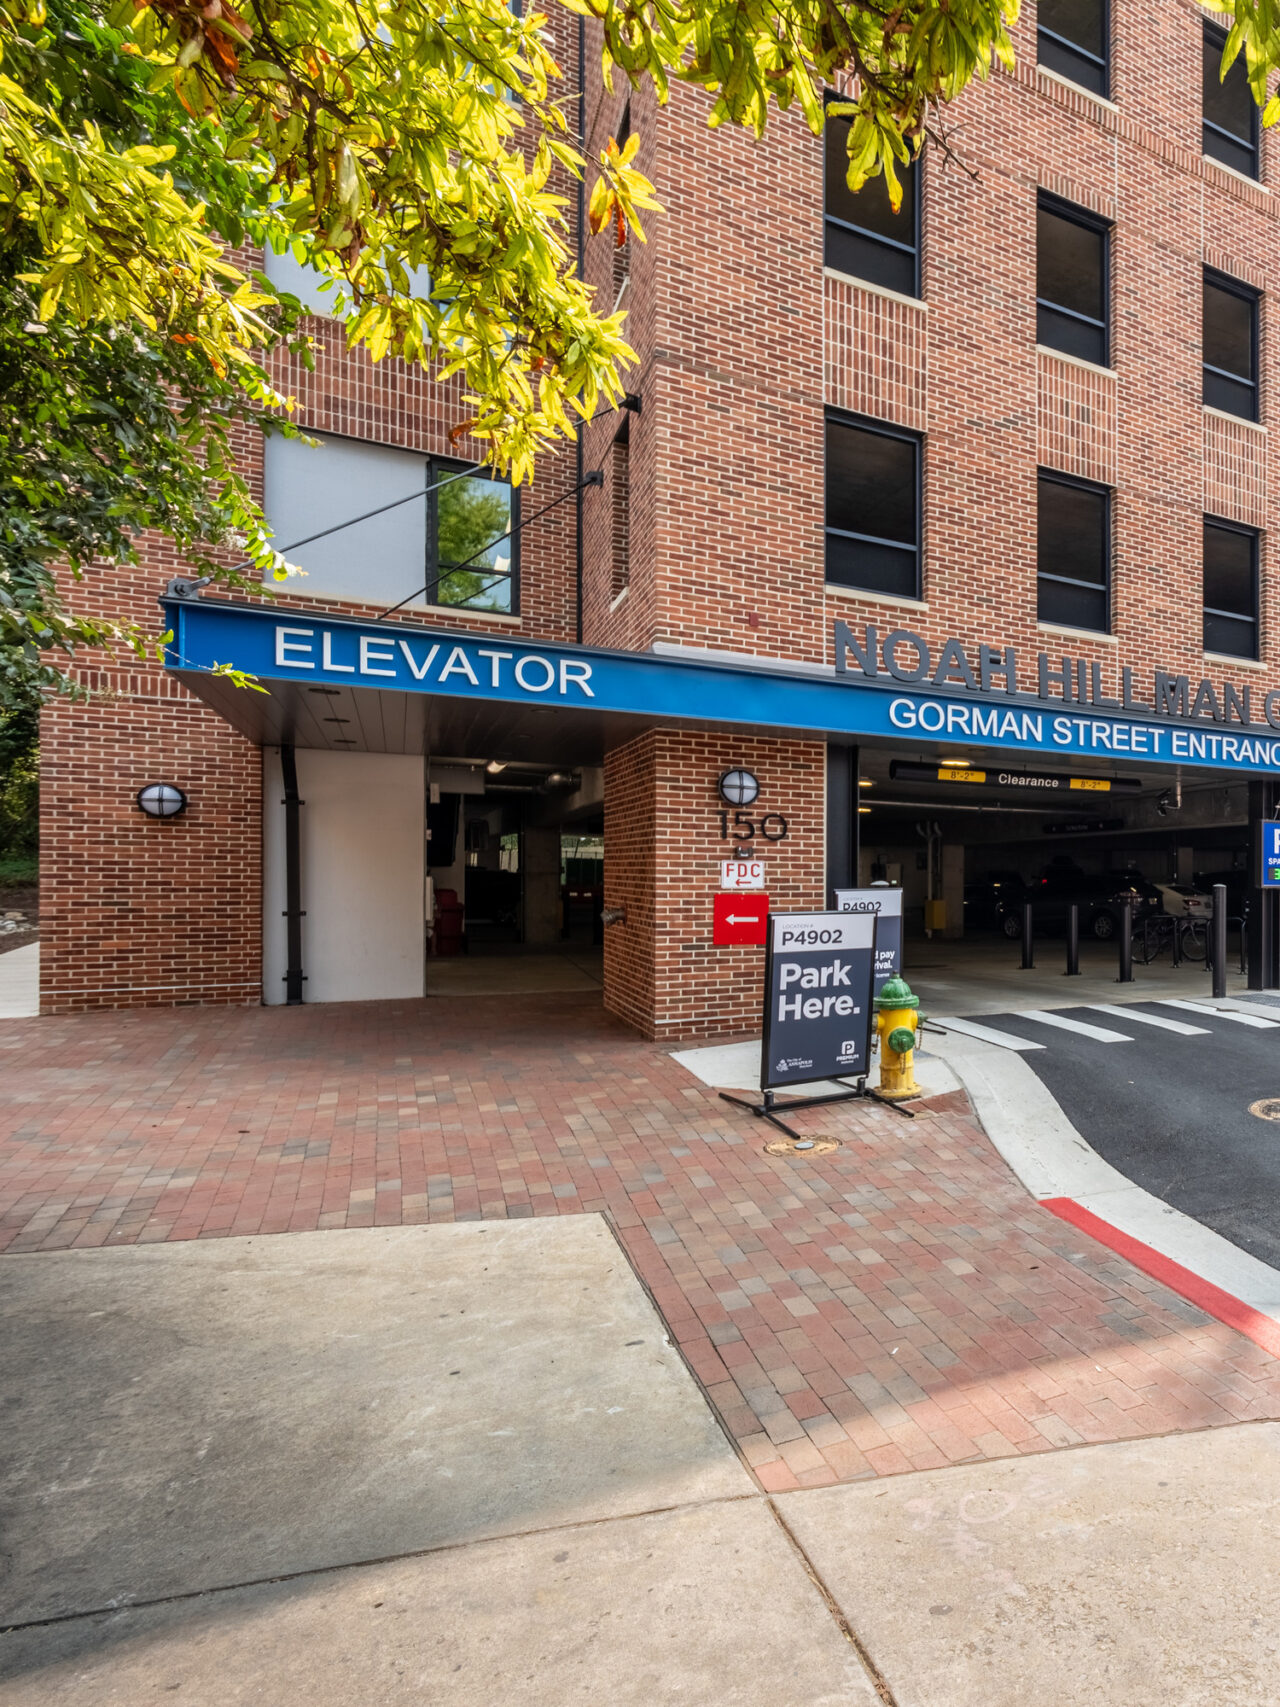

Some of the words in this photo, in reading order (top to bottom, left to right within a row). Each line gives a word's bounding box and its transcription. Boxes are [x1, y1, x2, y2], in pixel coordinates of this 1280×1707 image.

[275, 626, 596, 698] ELEVATOR
[834, 621, 1017, 695] NOAH
[1038, 653, 1251, 726] HILLMAN
[889, 698, 1043, 743] GORMAN
[1052, 716, 1165, 754] STREET
[998, 773, 1060, 788] Clearance
[717, 810, 788, 842] 150
[726, 863, 761, 878] FDC
[843, 901, 882, 912] P4902
[782, 929, 843, 946] P4902
[880, 950, 896, 960] pay
[779, 959, 853, 991] Park
[778, 993, 861, 1022] Here.
